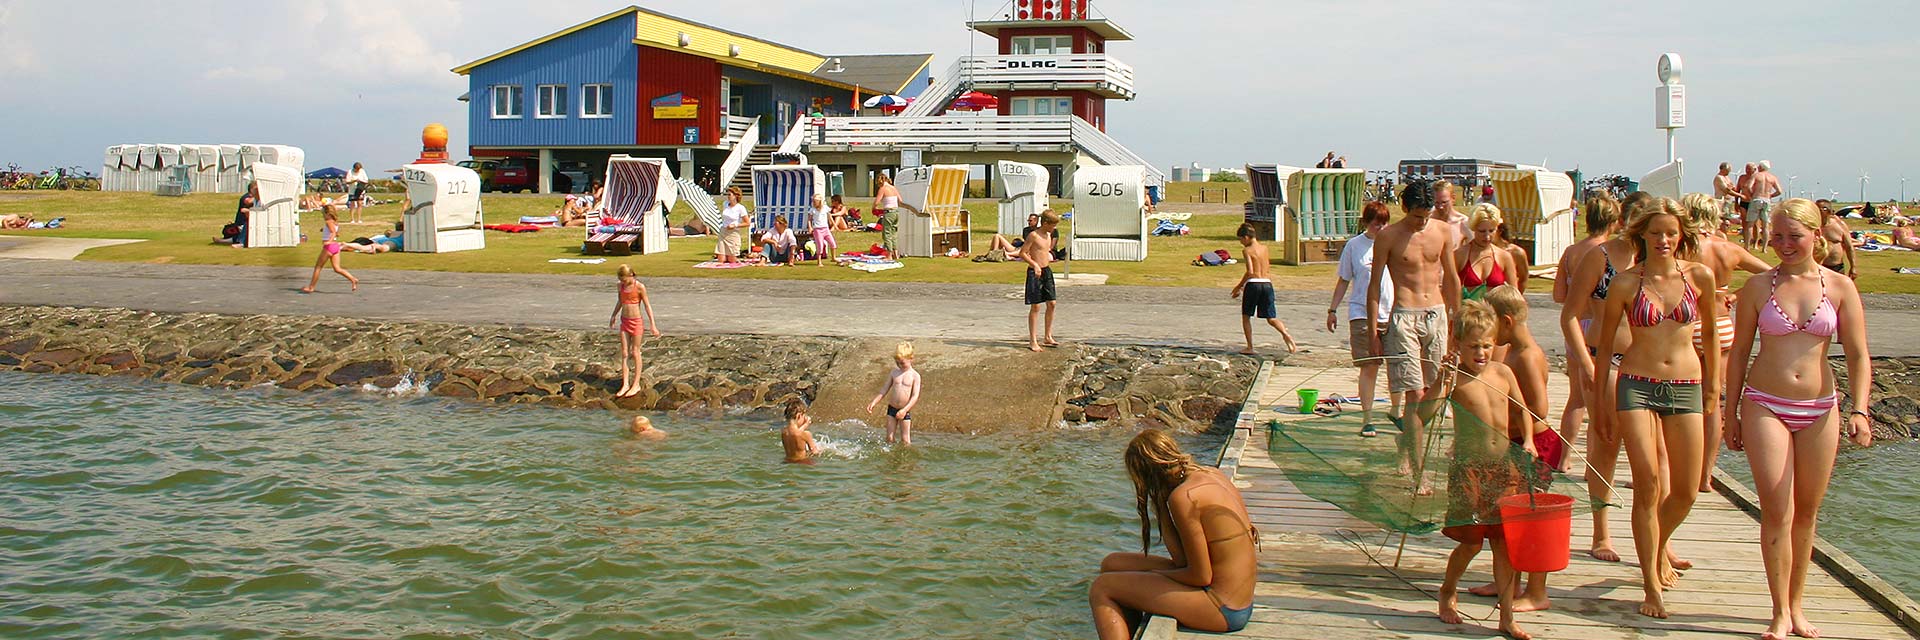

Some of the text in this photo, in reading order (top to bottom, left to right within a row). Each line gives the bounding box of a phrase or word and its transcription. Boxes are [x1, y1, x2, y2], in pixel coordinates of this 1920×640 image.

[913, 168, 928, 180] 73
[1003, 163, 1023, 174] 130
[406, 169, 426, 182] 212
[447, 180, 469, 195] 212
[1088, 182, 1124, 196] 206
